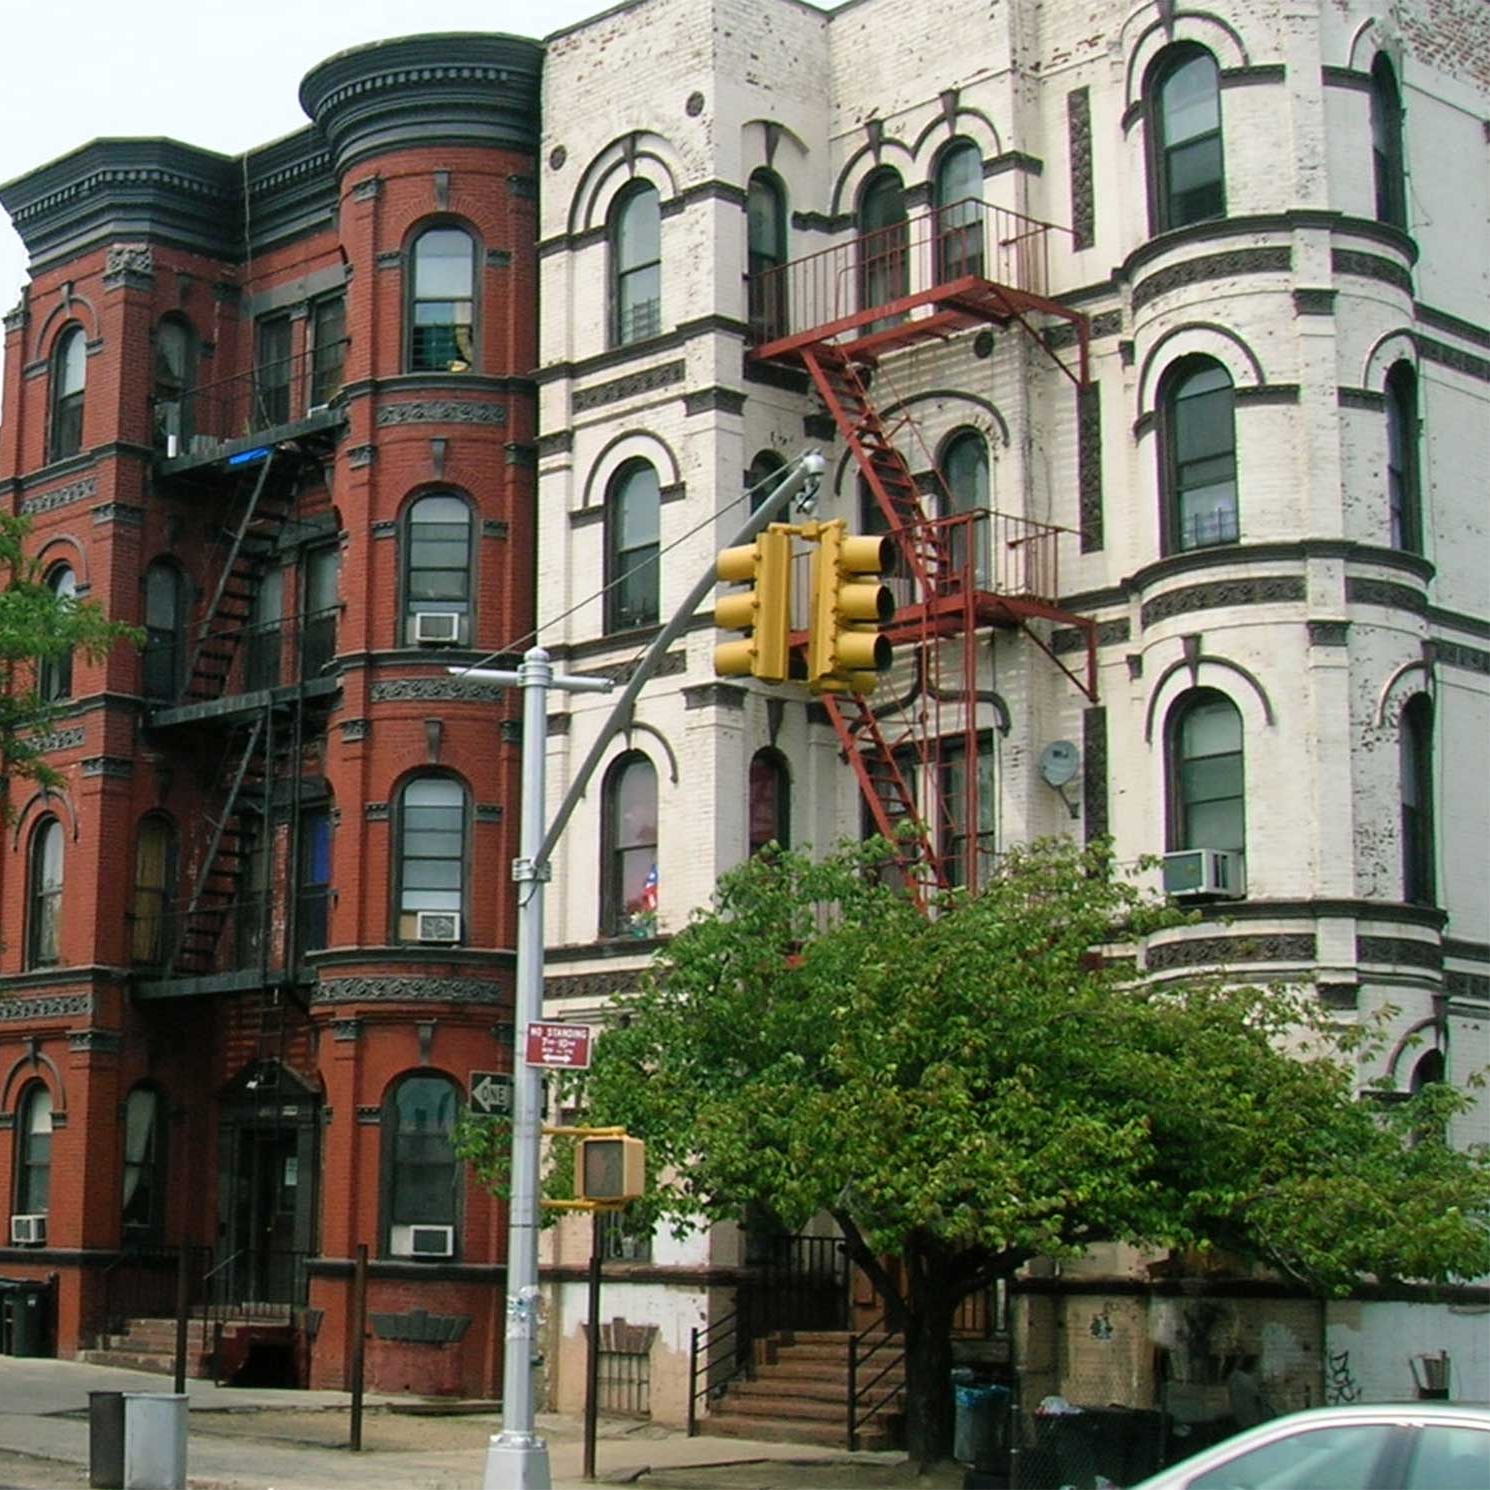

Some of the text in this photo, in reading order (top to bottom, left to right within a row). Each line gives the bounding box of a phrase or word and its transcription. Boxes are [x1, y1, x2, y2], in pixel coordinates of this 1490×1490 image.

[530, 1027, 587, 1039] NO STANDING
[482, 1085, 505, 1104] ONE
